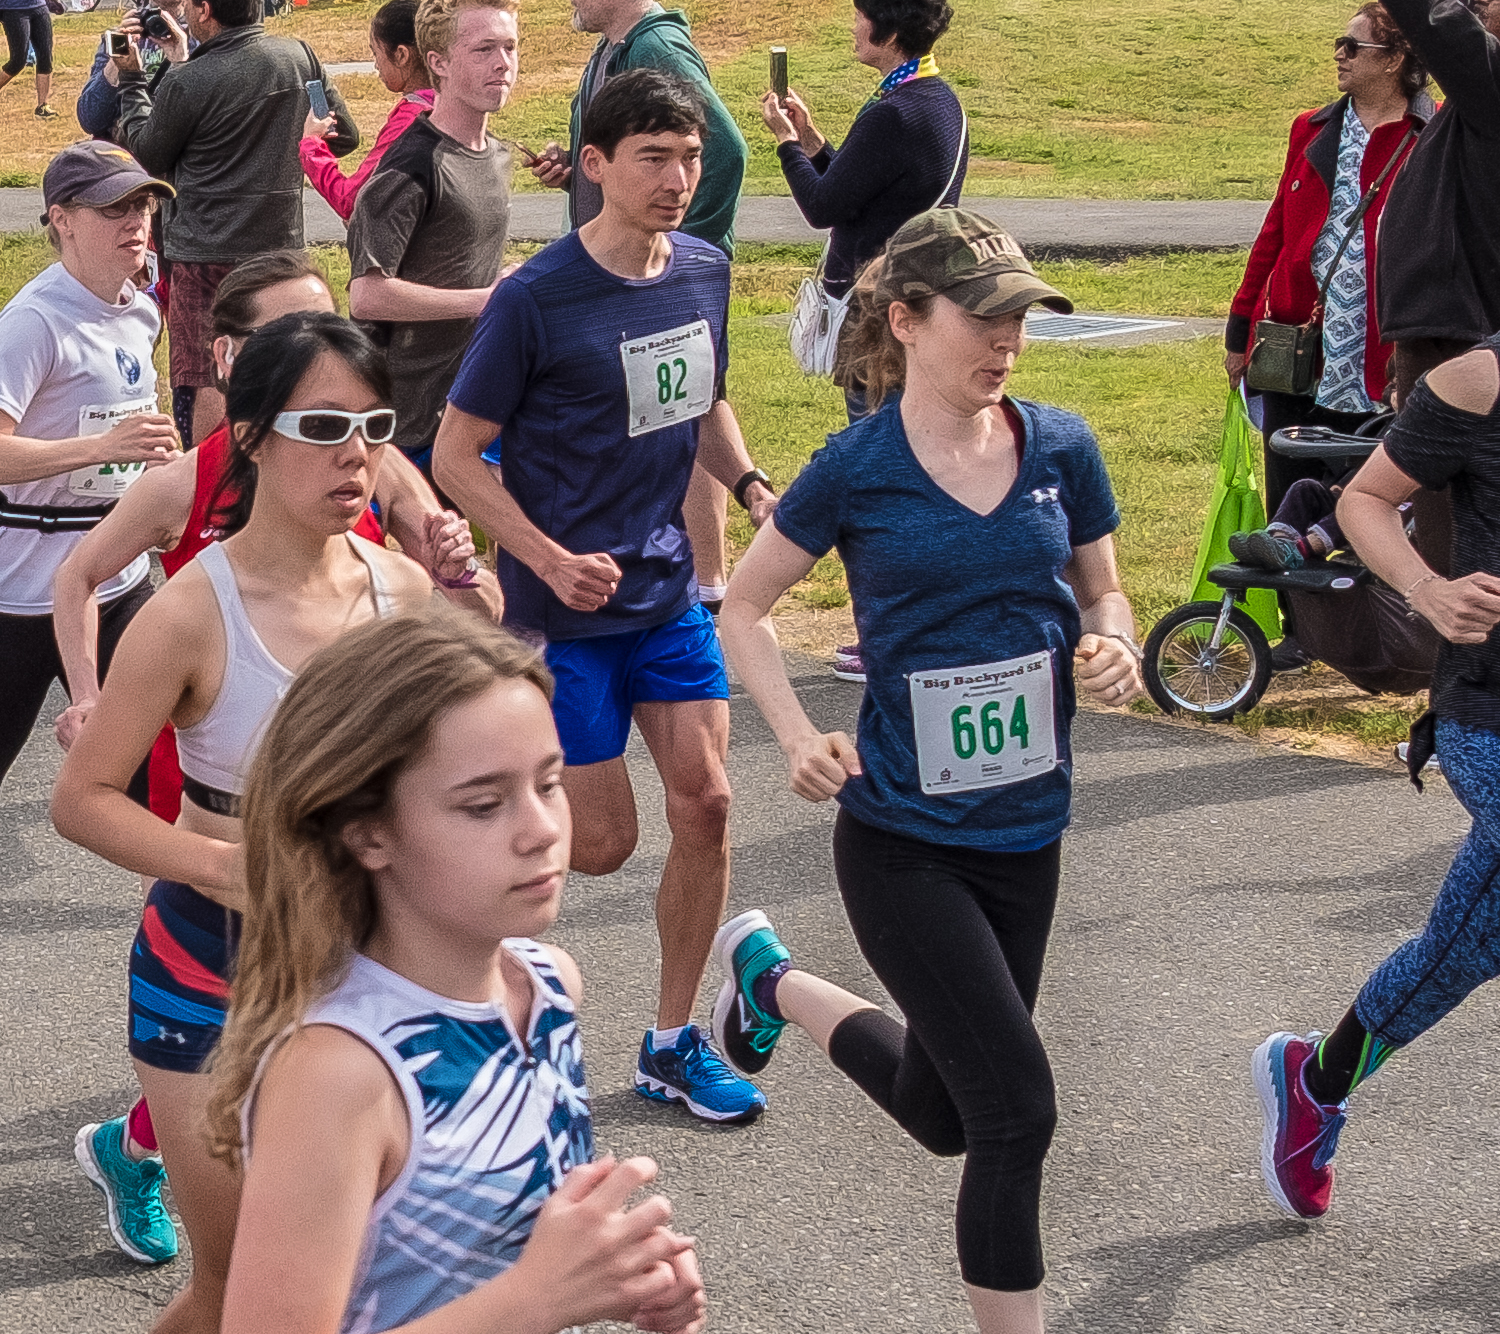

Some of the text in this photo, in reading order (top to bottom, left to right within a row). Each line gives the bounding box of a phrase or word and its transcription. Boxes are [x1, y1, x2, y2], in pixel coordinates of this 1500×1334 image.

[656, 357, 687, 405] 82
[89, 411, 107, 421] Big
[923, 679, 950, 690] Big
[953, 665, 1025, 685] Backyard
[951, 694, 1030, 760] 664
